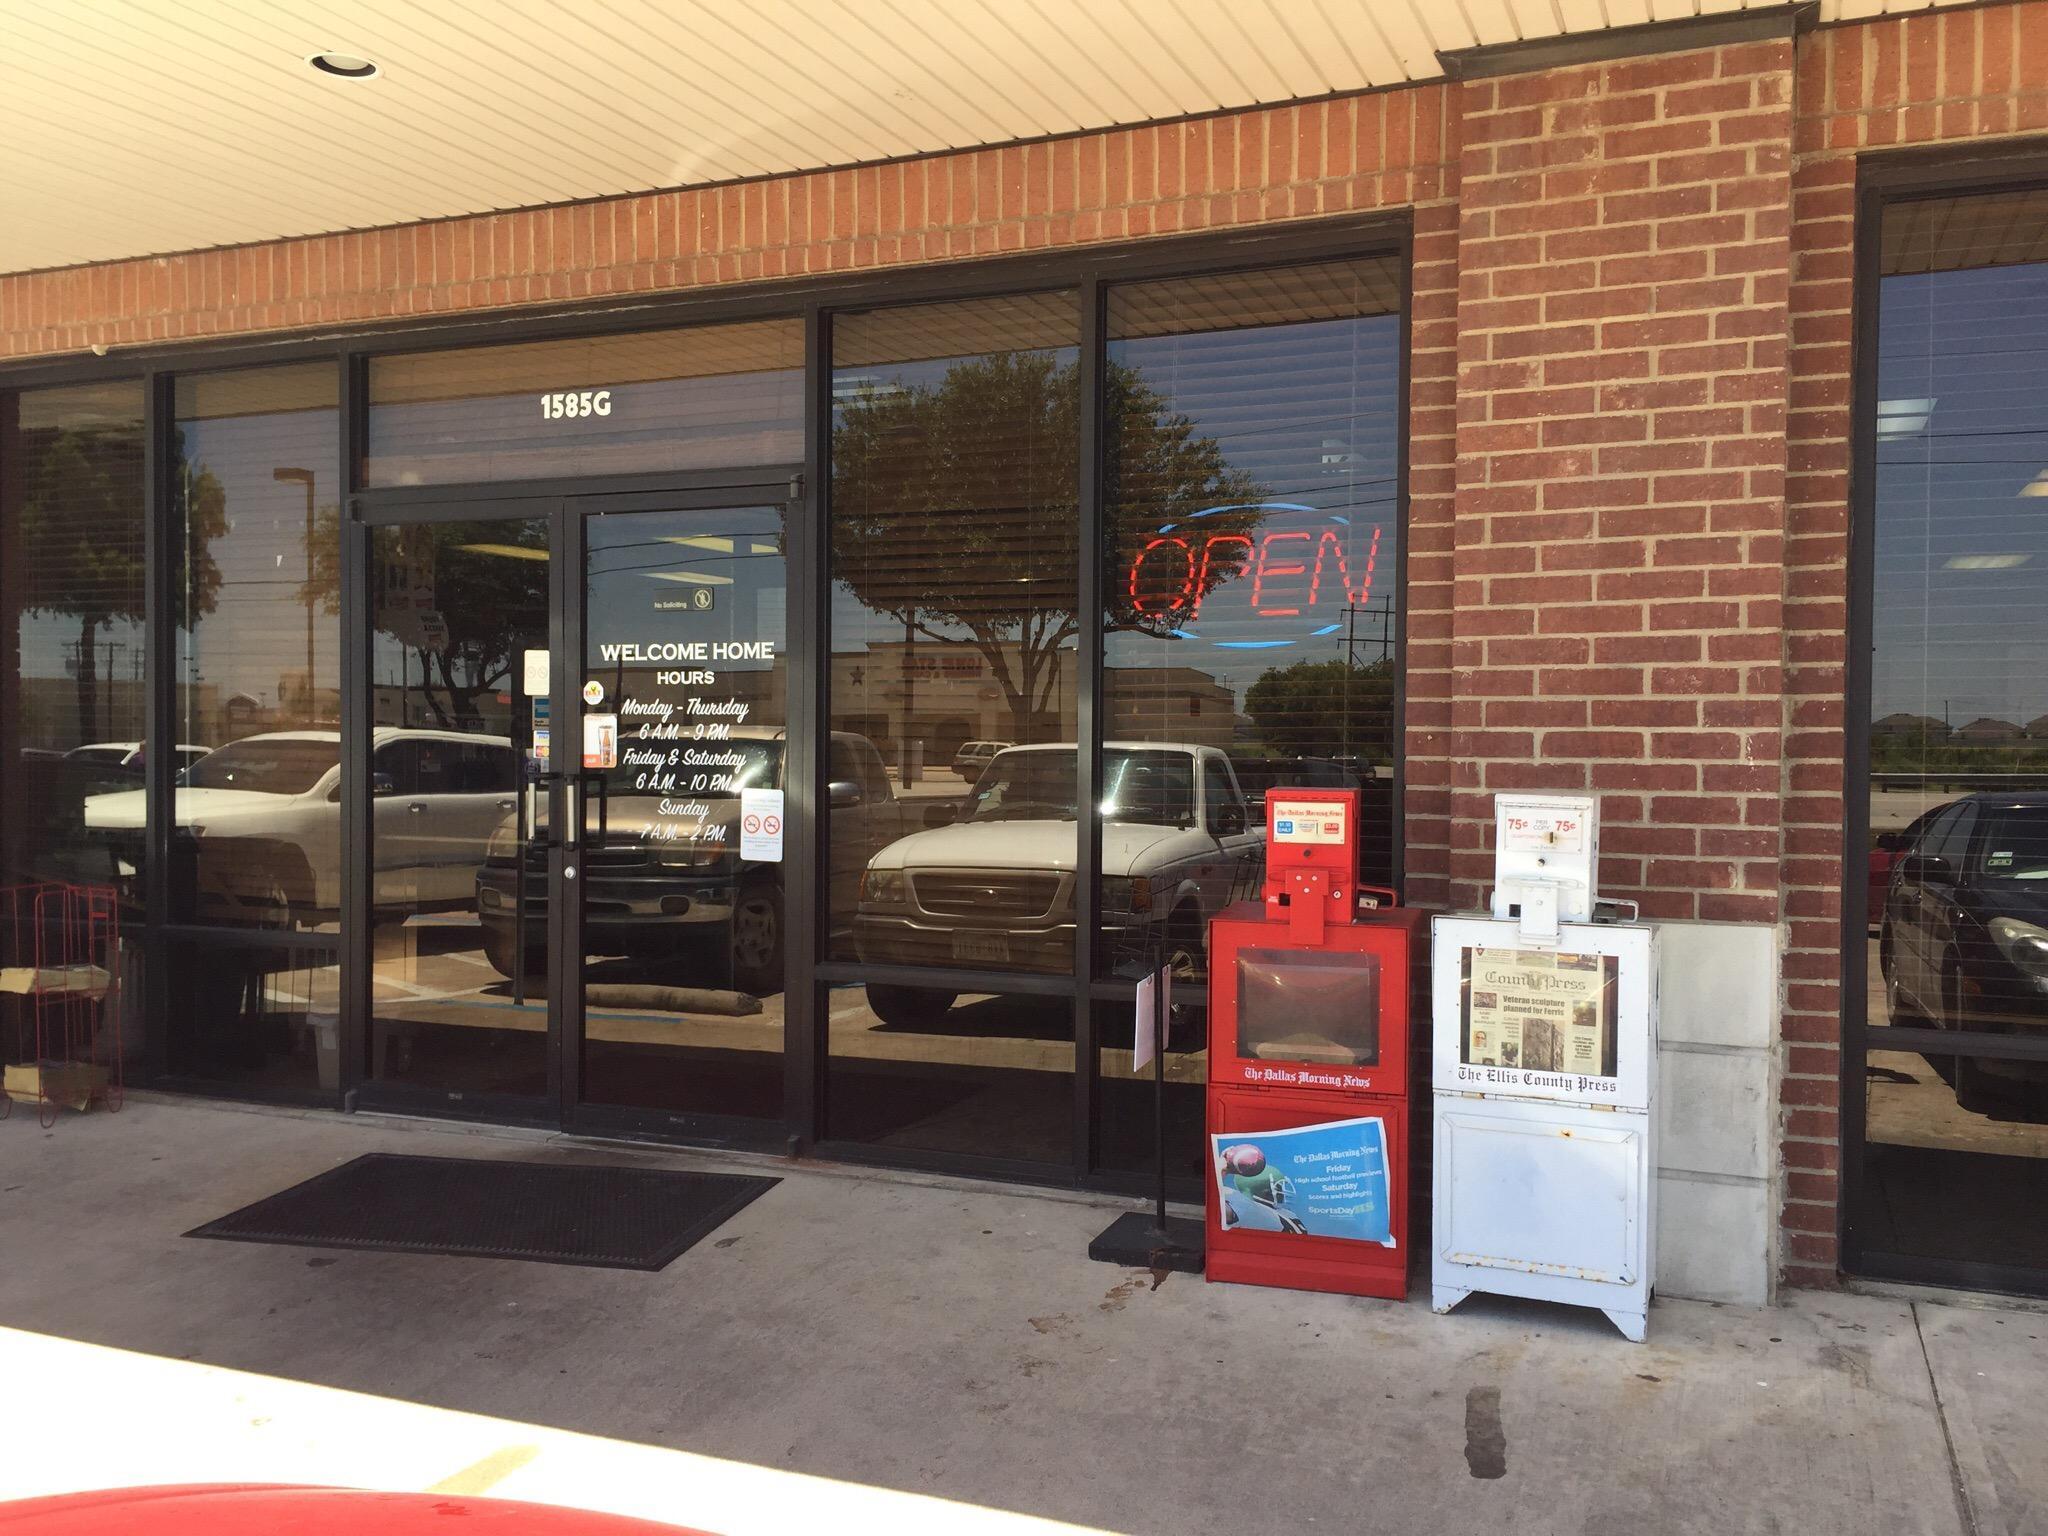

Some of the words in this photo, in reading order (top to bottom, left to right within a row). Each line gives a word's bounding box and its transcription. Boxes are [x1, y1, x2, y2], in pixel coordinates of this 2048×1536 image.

[541, 391, 611, 419] 1585G
[1130, 528, 1381, 619] OPEN
[600, 643, 708, 661] WELCOME
[713, 642, 775, 660] HOME
[657, 671, 715, 685] HOURS
[621, 698, 673, 723] Monday
[686, 698, 749, 723] Thursday
[640, 723, 650, 740] 6
[652, 724, 679, 740] A.M.
[693, 723, 704, 740] 9
[707, 724, 730, 740] P.M.
[623, 748, 666, 772] Friday
[668, 748, 680, 765] &
[682, 748, 747, 774] Saturday
[636, 773, 646, 789] 6
[648, 773, 675, 790] A.M.
[690, 774, 707, 790] 10
[709, 774, 732, 791] P.M.
[658, 798, 710, 823] Sunday
[640, 823, 652, 839] 7
[650, 824, 678, 840] A.M.
[689, 825, 702, 840] 2
[704, 825, 727, 841] P.M.
[1508, 818, 1529, 830] 75¢
[1555, 820, 1577, 832] 75¢
[1545, 974, 1586, 991] Press
[1503, 995, 1530, 1004] Veteran
[1531, 997, 1565, 1008] sculpture
[1503, 1005, 1531, 1014] planned
[1532, 1006, 1543, 1014] for
[1244, 1067, 1261, 1080] The
[1264, 1069, 1296, 1082] Dallas
[1298, 1071, 1341, 1087] Morning
[1343, 1074, 1371, 1088] News
[1458, 1067, 1482, 1083] The
[1487, 1069, 1518, 1084] Ellis
[1523, 1073, 1573, 1091] County
[1578, 1077, 1617, 1092] Press
[1294, 1154, 1307, 1164] The
[1309, 1152, 1330, 1162] Dallas
[1330, 1149, 1360, 1160] Morning
[1360, 1146, 1378, 1155] News
[1326, 1165, 1351, 1173] Friday
[1322, 1182, 1358, 1192] Saturday
